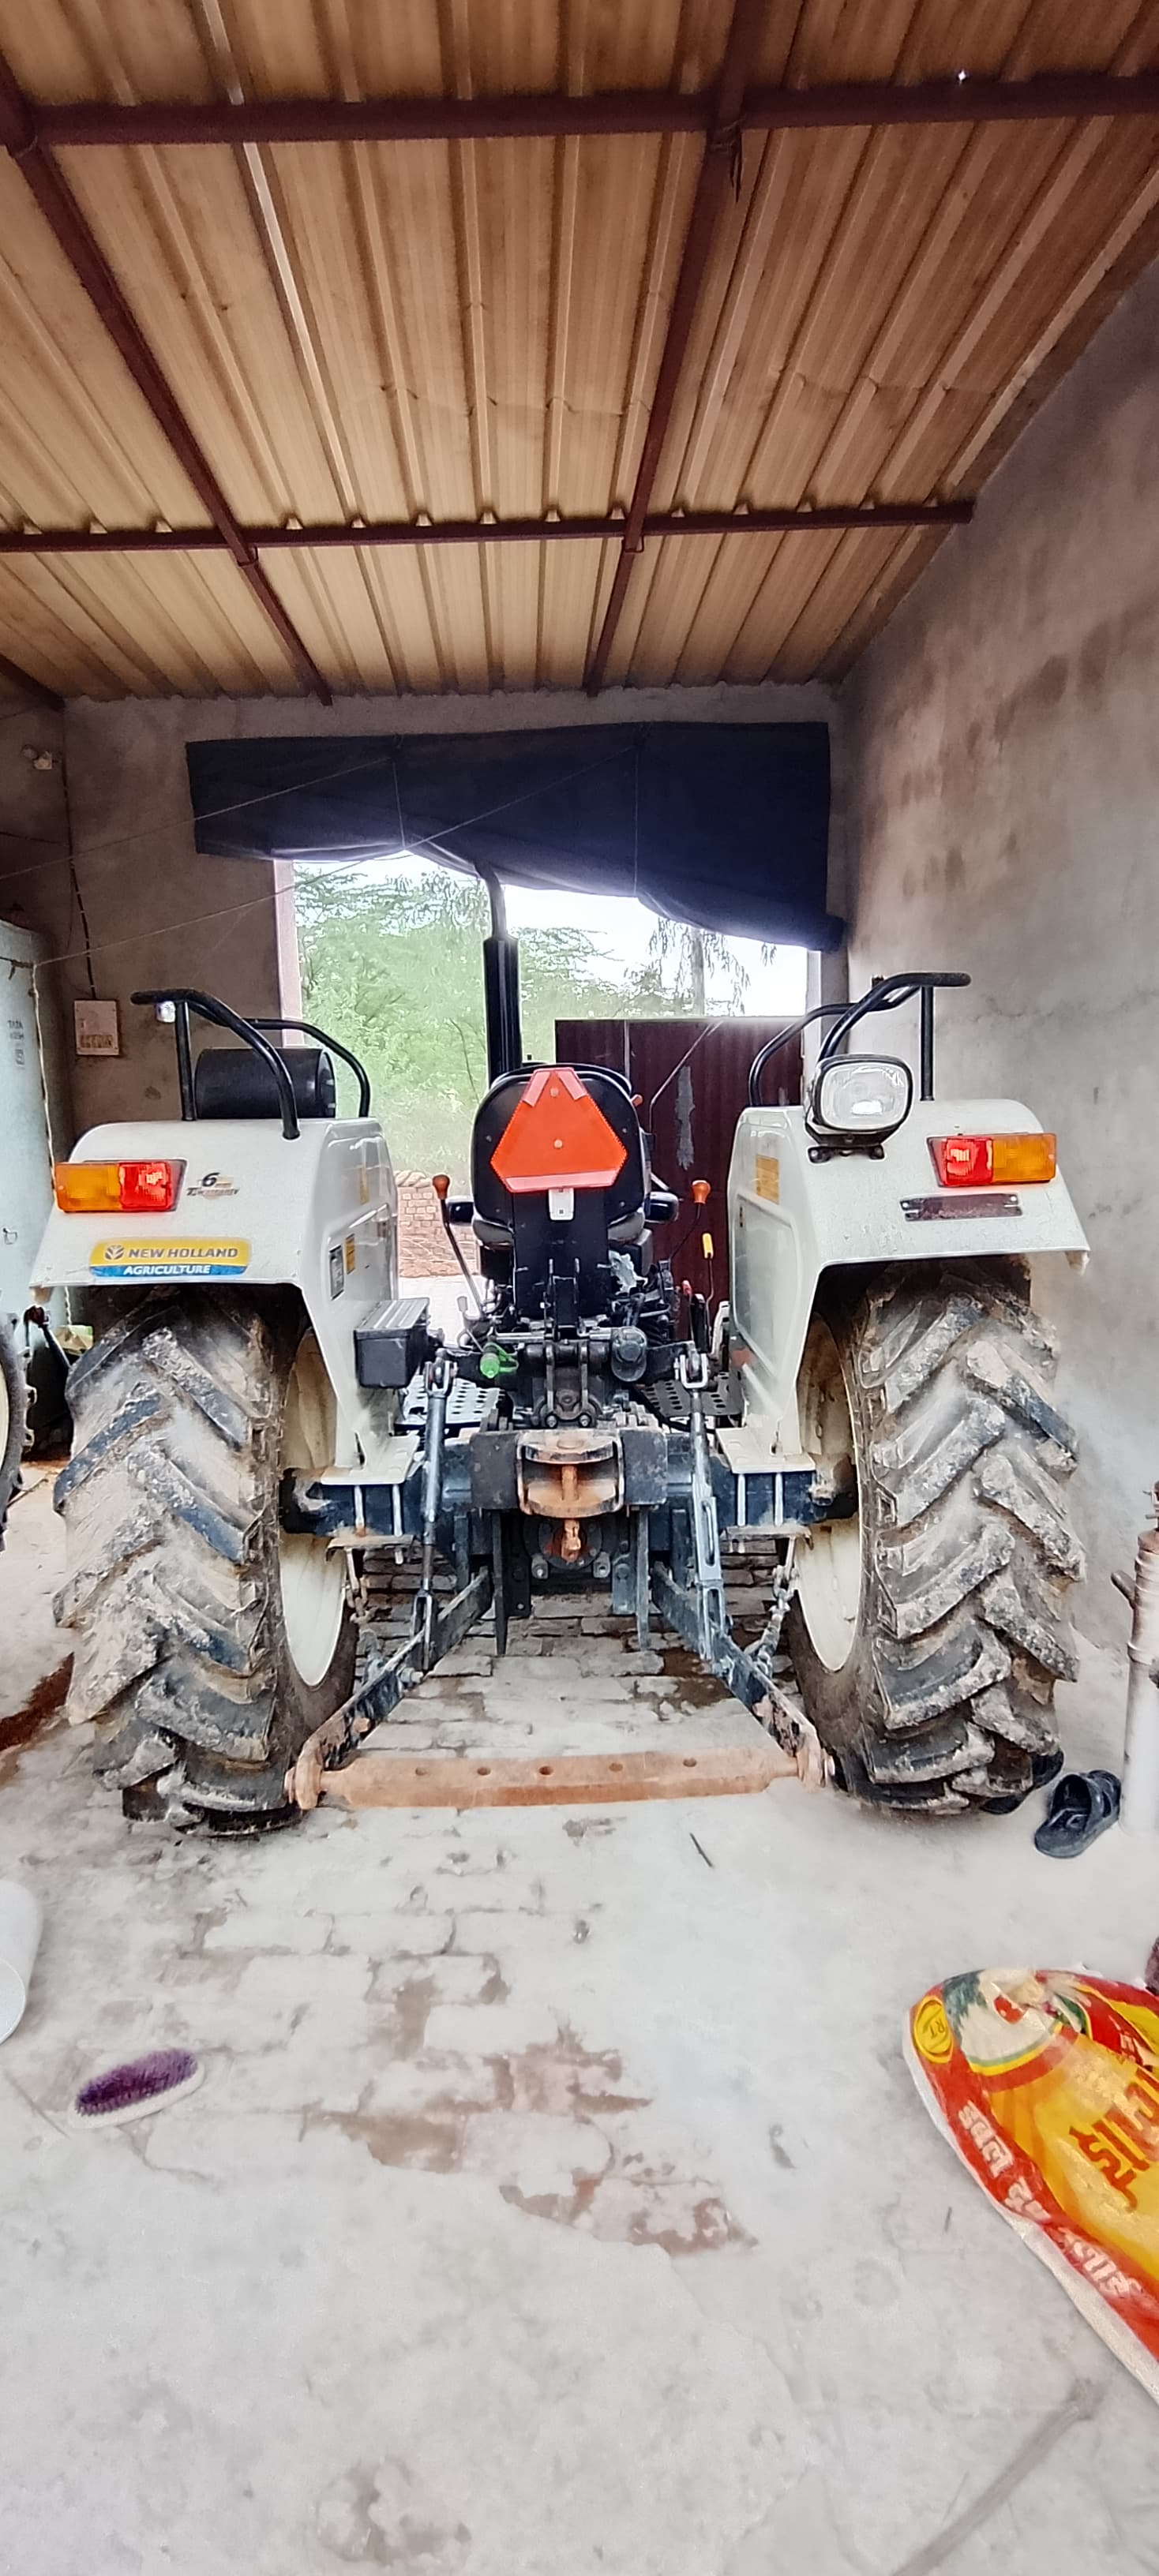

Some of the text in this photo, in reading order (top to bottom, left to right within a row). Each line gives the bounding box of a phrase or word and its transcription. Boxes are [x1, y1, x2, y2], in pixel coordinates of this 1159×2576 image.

[202, 1172, 220, 1187] 6
[129, 1248, 238, 1258] NEW HOLLAND
[123, 1265, 212, 1275] AGRICULTURE
[958, 2099, 1015, 2178] डबल
